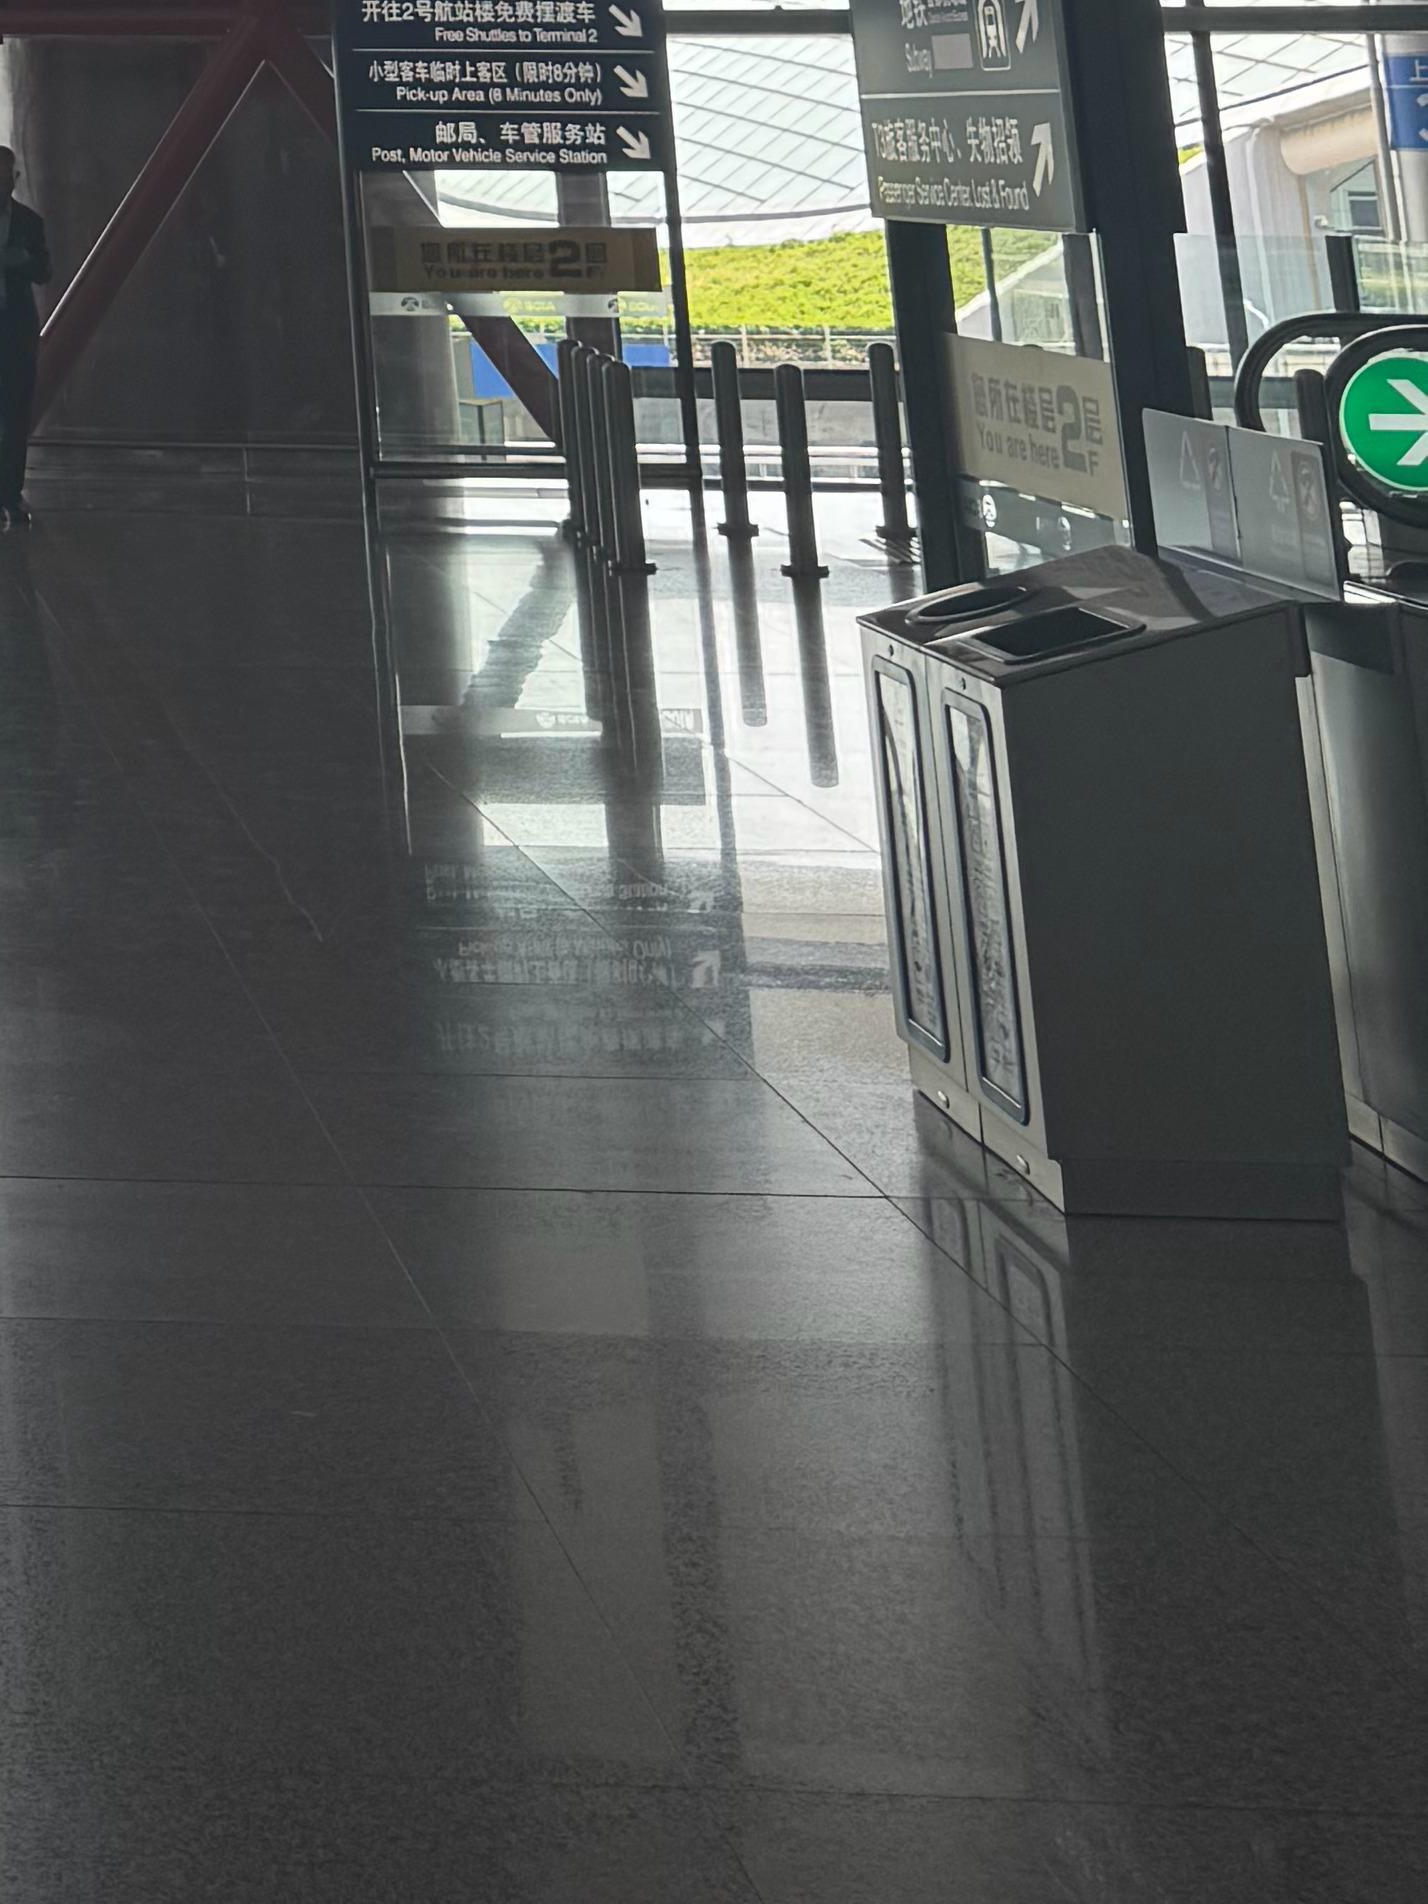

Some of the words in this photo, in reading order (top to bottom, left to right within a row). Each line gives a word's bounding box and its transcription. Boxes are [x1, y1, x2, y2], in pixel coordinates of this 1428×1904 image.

[362, 0, 596, 23] 开往2号航站楼免费摆渡车
[435, 28, 463, 42] Free
[519, 29, 531, 42] to
[532, 28, 587, 42] Terminal
[589, 29, 598, 42] 2
[396, 87, 448, 103] Pick-up
[452, 88, 485, 102] Area
[506, 88, 561, 103] Minutes
[564, 88, 602, 105] Only)
[372, 148, 405, 164] Post,
[409, 148, 449, 163] Motor
[452, 149, 501, 163] Vehicle
[505, 149, 555, 163] Service
[559, 149, 608, 164] Station
[1056, 384, 1088, 473] 2
[976, 420, 1003, 454] You
[1007, 435, 1027, 461] are
[1028, 432, 1061, 470] here
[1088, 450, 1099, 477] F
